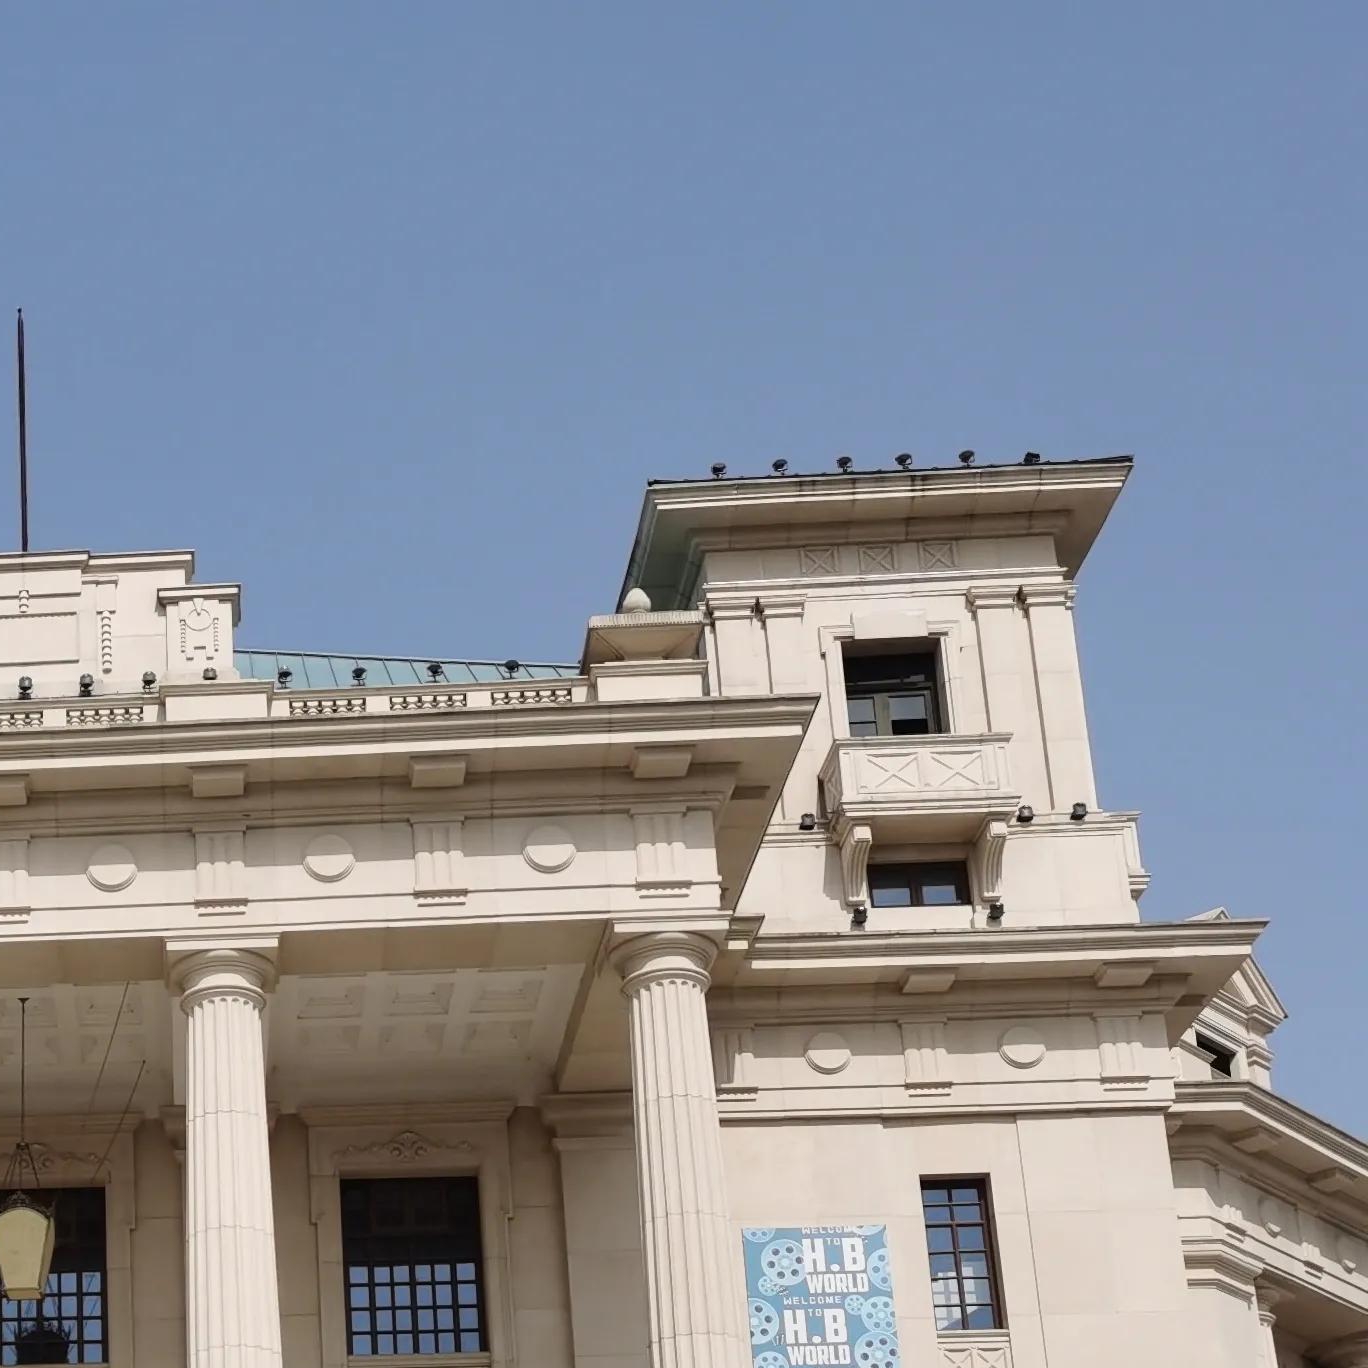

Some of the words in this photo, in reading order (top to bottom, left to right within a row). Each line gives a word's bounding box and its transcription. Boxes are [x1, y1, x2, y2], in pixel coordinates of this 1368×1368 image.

[802, 1238, 866, 1272] H.B
[807, 1273, 869, 1293] WORLD
[784, 1296, 842, 1305] WELCOME
[808, 1309, 822, 1317] TO
[784, 1308, 848, 1344] H.B
[787, 1345, 851, 1365] WORLD
